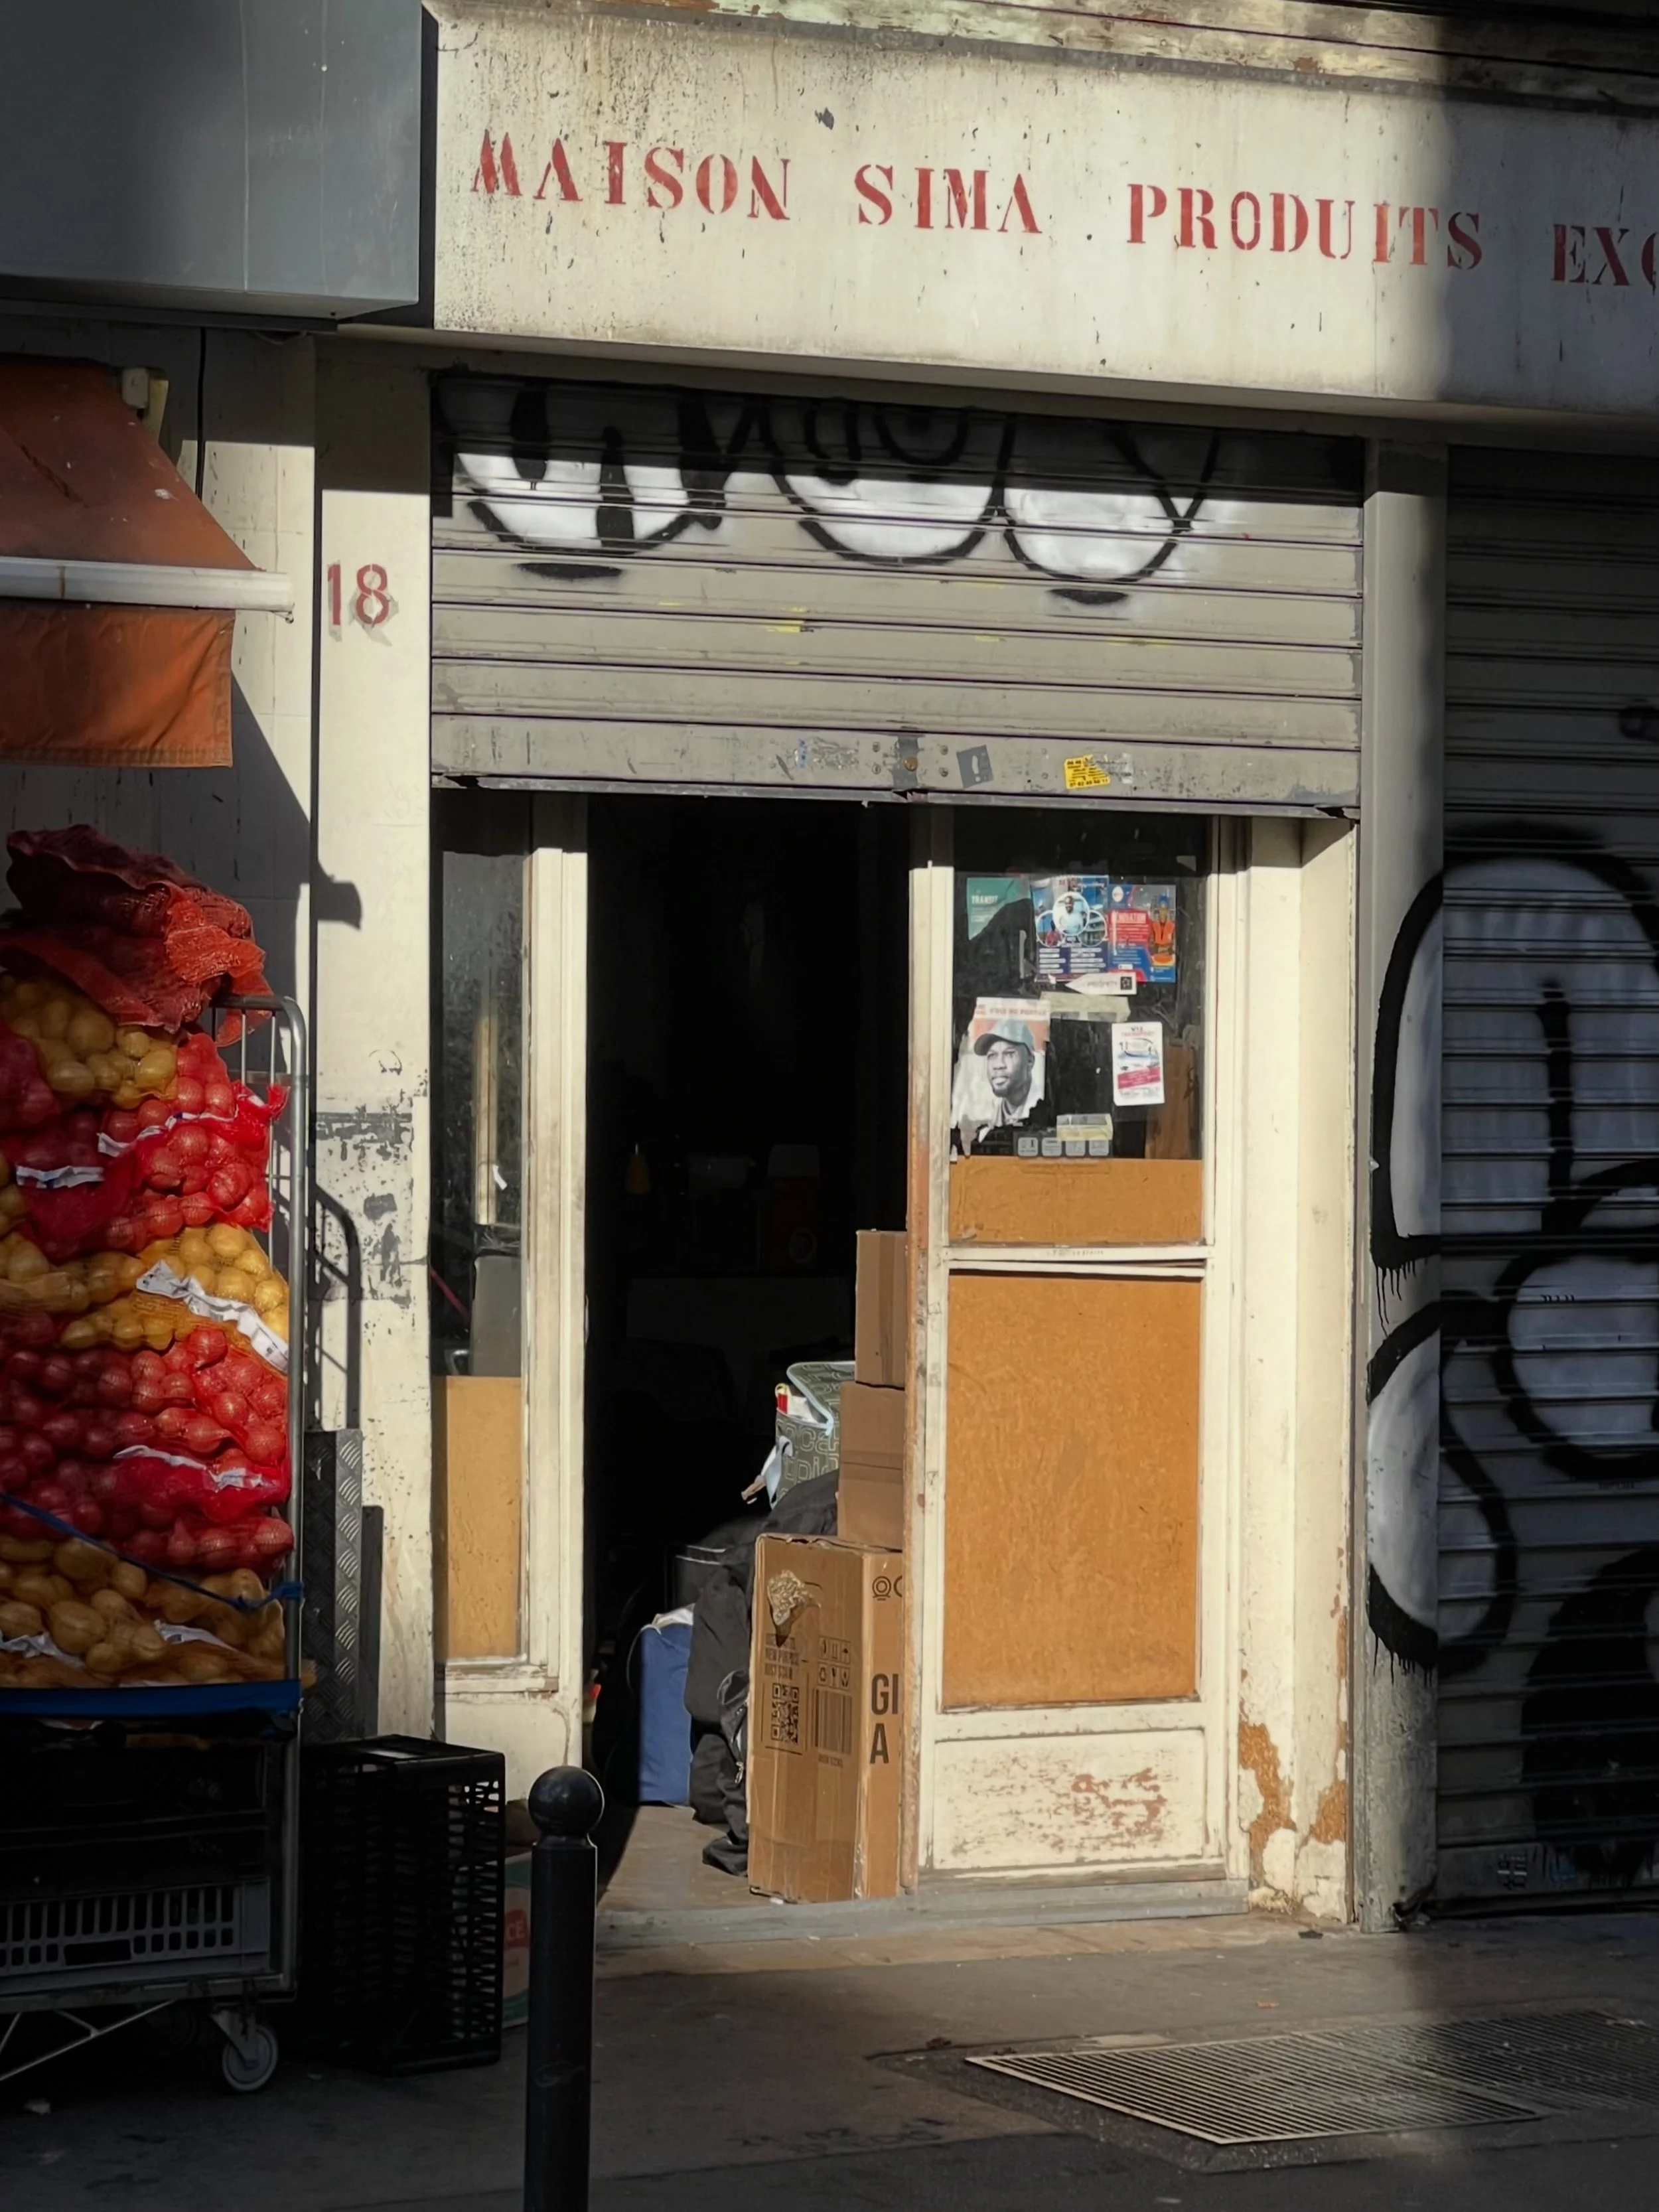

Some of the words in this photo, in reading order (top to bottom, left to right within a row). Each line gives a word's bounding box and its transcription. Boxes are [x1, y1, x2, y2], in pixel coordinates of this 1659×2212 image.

[471, 131, 791, 220] MAISON
[854, 163, 1043, 234] SIMA
[1127, 183, 1482, 269] PRODUITS
[328, 564, 390, 625] 18
[871, 1673, 899, 1716] GI
[869, 1722, 889, 1765] A
